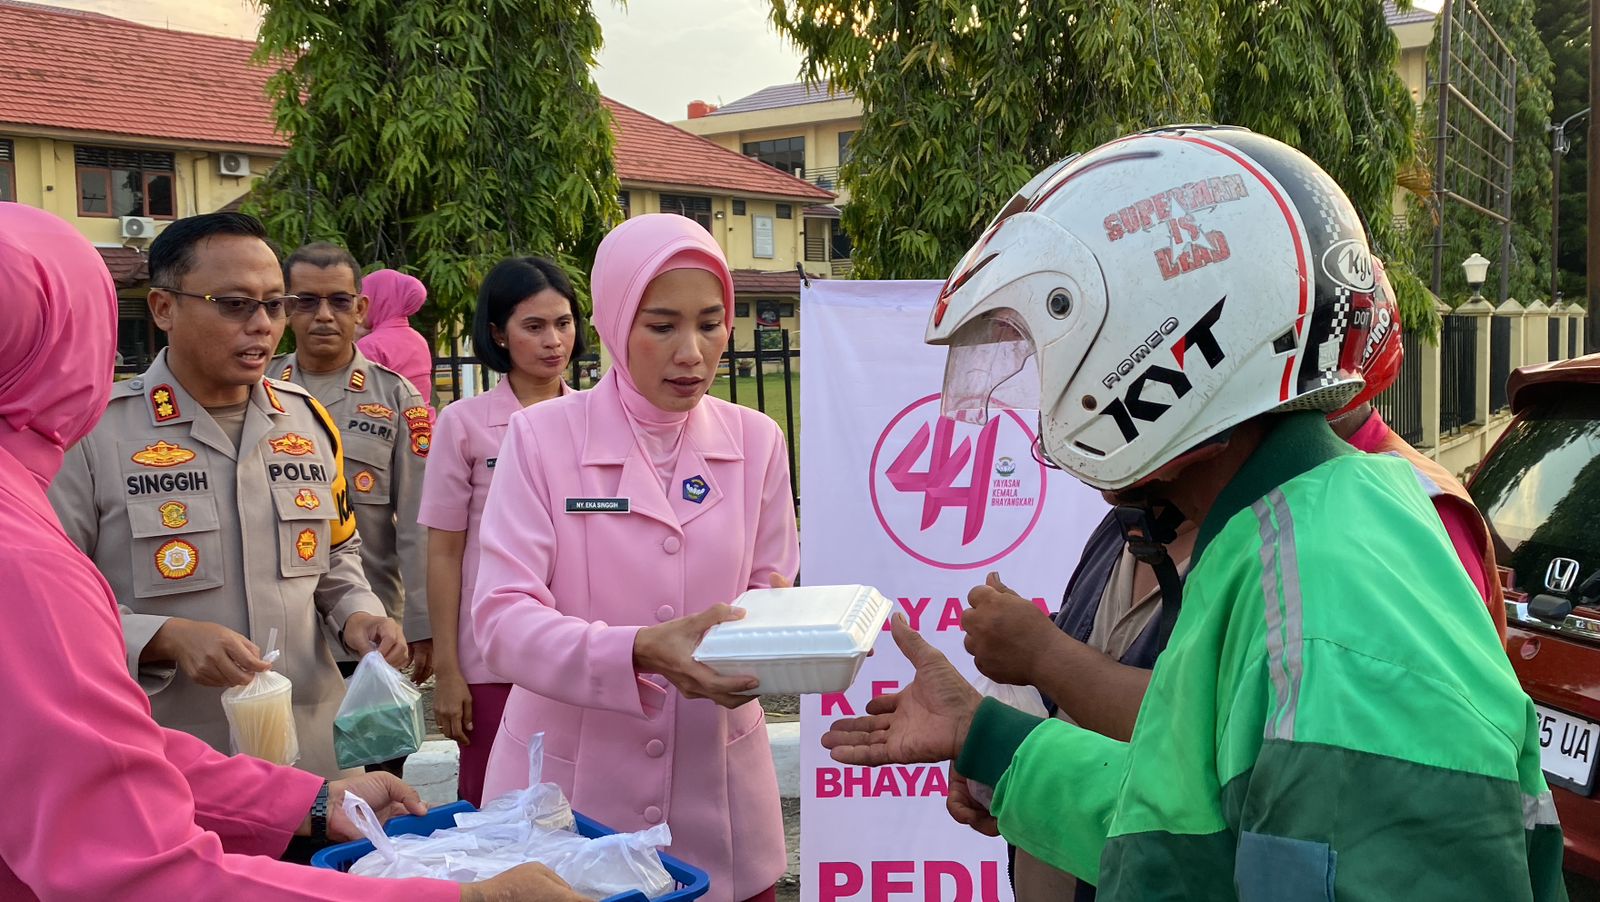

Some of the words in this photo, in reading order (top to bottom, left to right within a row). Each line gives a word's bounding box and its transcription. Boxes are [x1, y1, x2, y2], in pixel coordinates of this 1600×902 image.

[1104, 173, 1250, 242] SUPERMAN
[1167, 215, 1200, 245] IS
[1353, 311, 1370, 325] DOT
[1101, 316, 1180, 390] ROMEO
[1100, 295, 1227, 444] KYT
[348, 420, 393, 440] POLRI
[126, 471, 209, 495] SINGGIH
[268, 462, 327, 483] POLRI
[992, 489, 1018, 497] KEMALA
[993, 479, 1021, 488] YAYASAN
[585, 501, 597, 509] EKA
[991, 498, 1034, 506] BHAYANGKARI
[1560, 722, 1591, 763] UA
